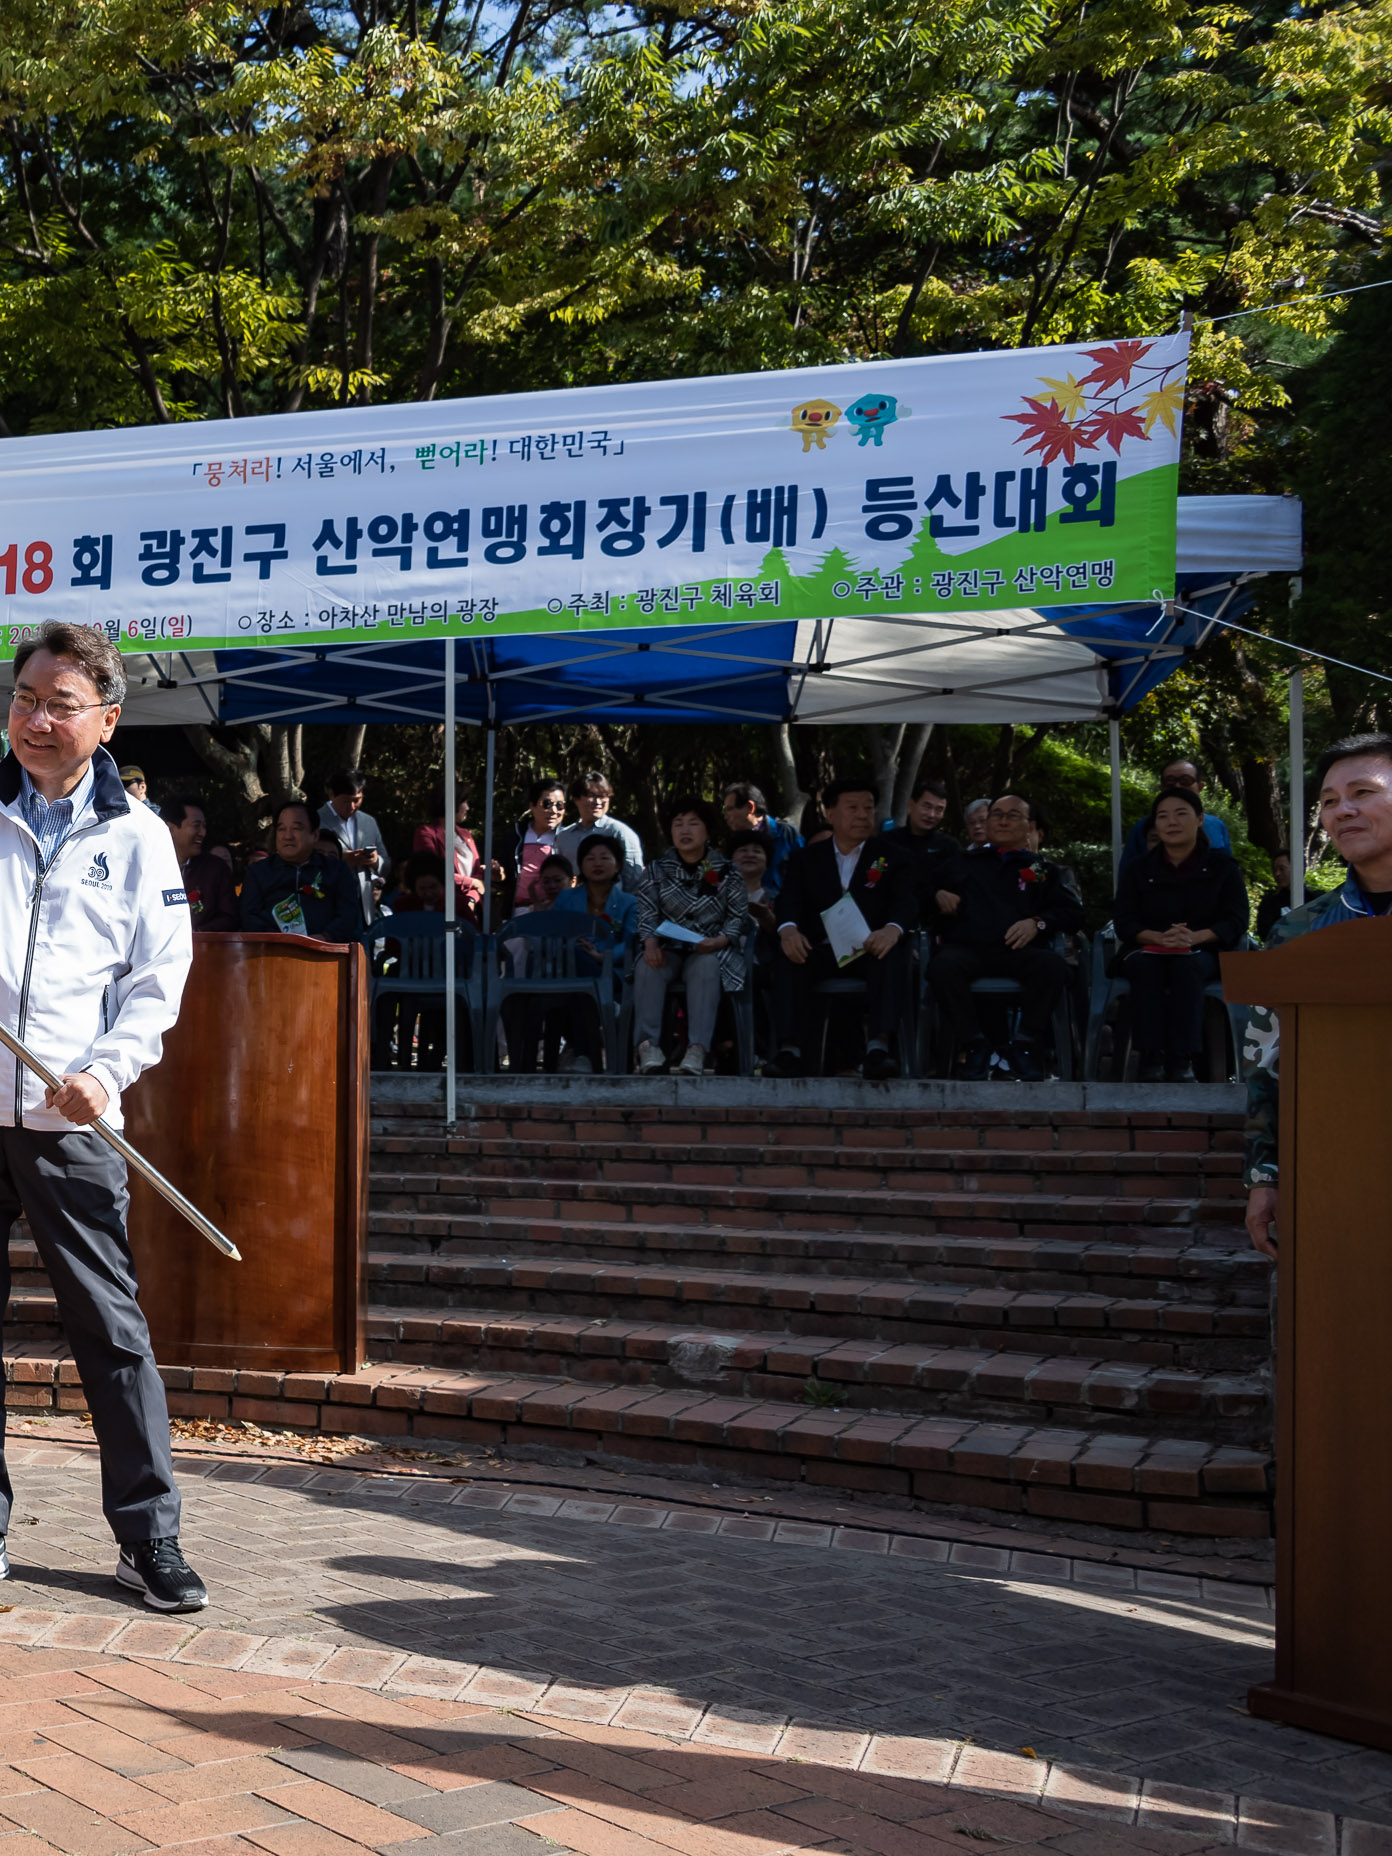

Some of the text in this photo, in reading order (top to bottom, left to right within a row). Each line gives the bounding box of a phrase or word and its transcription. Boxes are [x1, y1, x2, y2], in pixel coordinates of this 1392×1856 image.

[291, 447, 396, 480] 서울에서,
[415, 438, 498, 471] 뻗어라!
[70, 533, 114, 591] 회
[138, 522, 290, 588] 광진구
[861, 460, 1119, 542] 등산대회
[635, 585, 704, 613] 광진구
[710, 580, 781, 608] 체육회
[931, 569, 1006, 598] 광진구
[1012, 559, 1115, 593] 산악연맹
[318, 603, 380, 630] 아차산
[387, 599, 448, 627] 만남의
[456, 597, 500, 623] 광장
